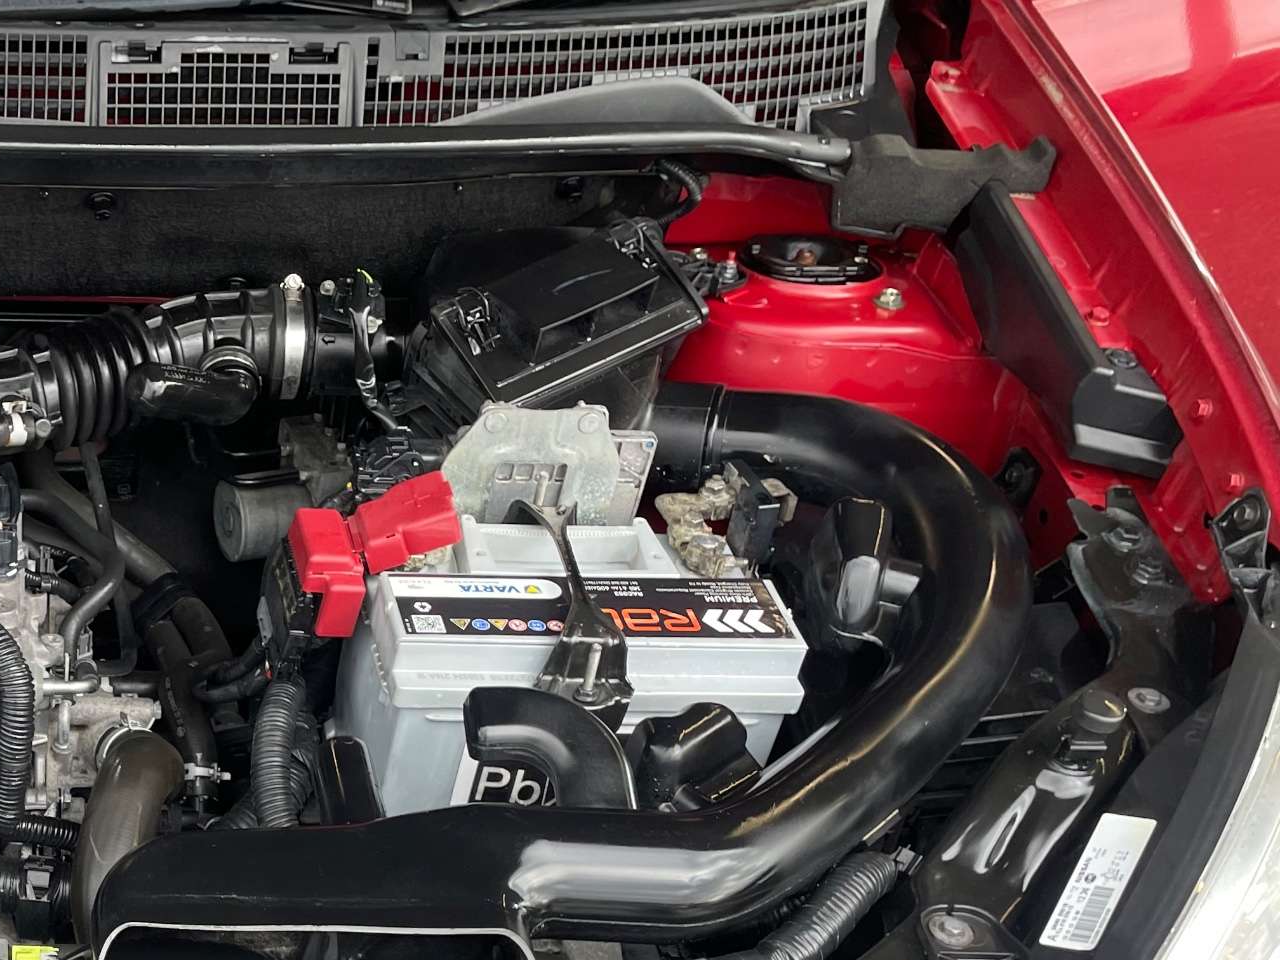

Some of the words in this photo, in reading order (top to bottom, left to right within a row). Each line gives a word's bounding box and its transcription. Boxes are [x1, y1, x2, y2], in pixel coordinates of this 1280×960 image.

[459, 584, 520, 594] VARTA
[704, 596, 758, 604] PREMIUM
[474, 765, 542, 806] Pb
